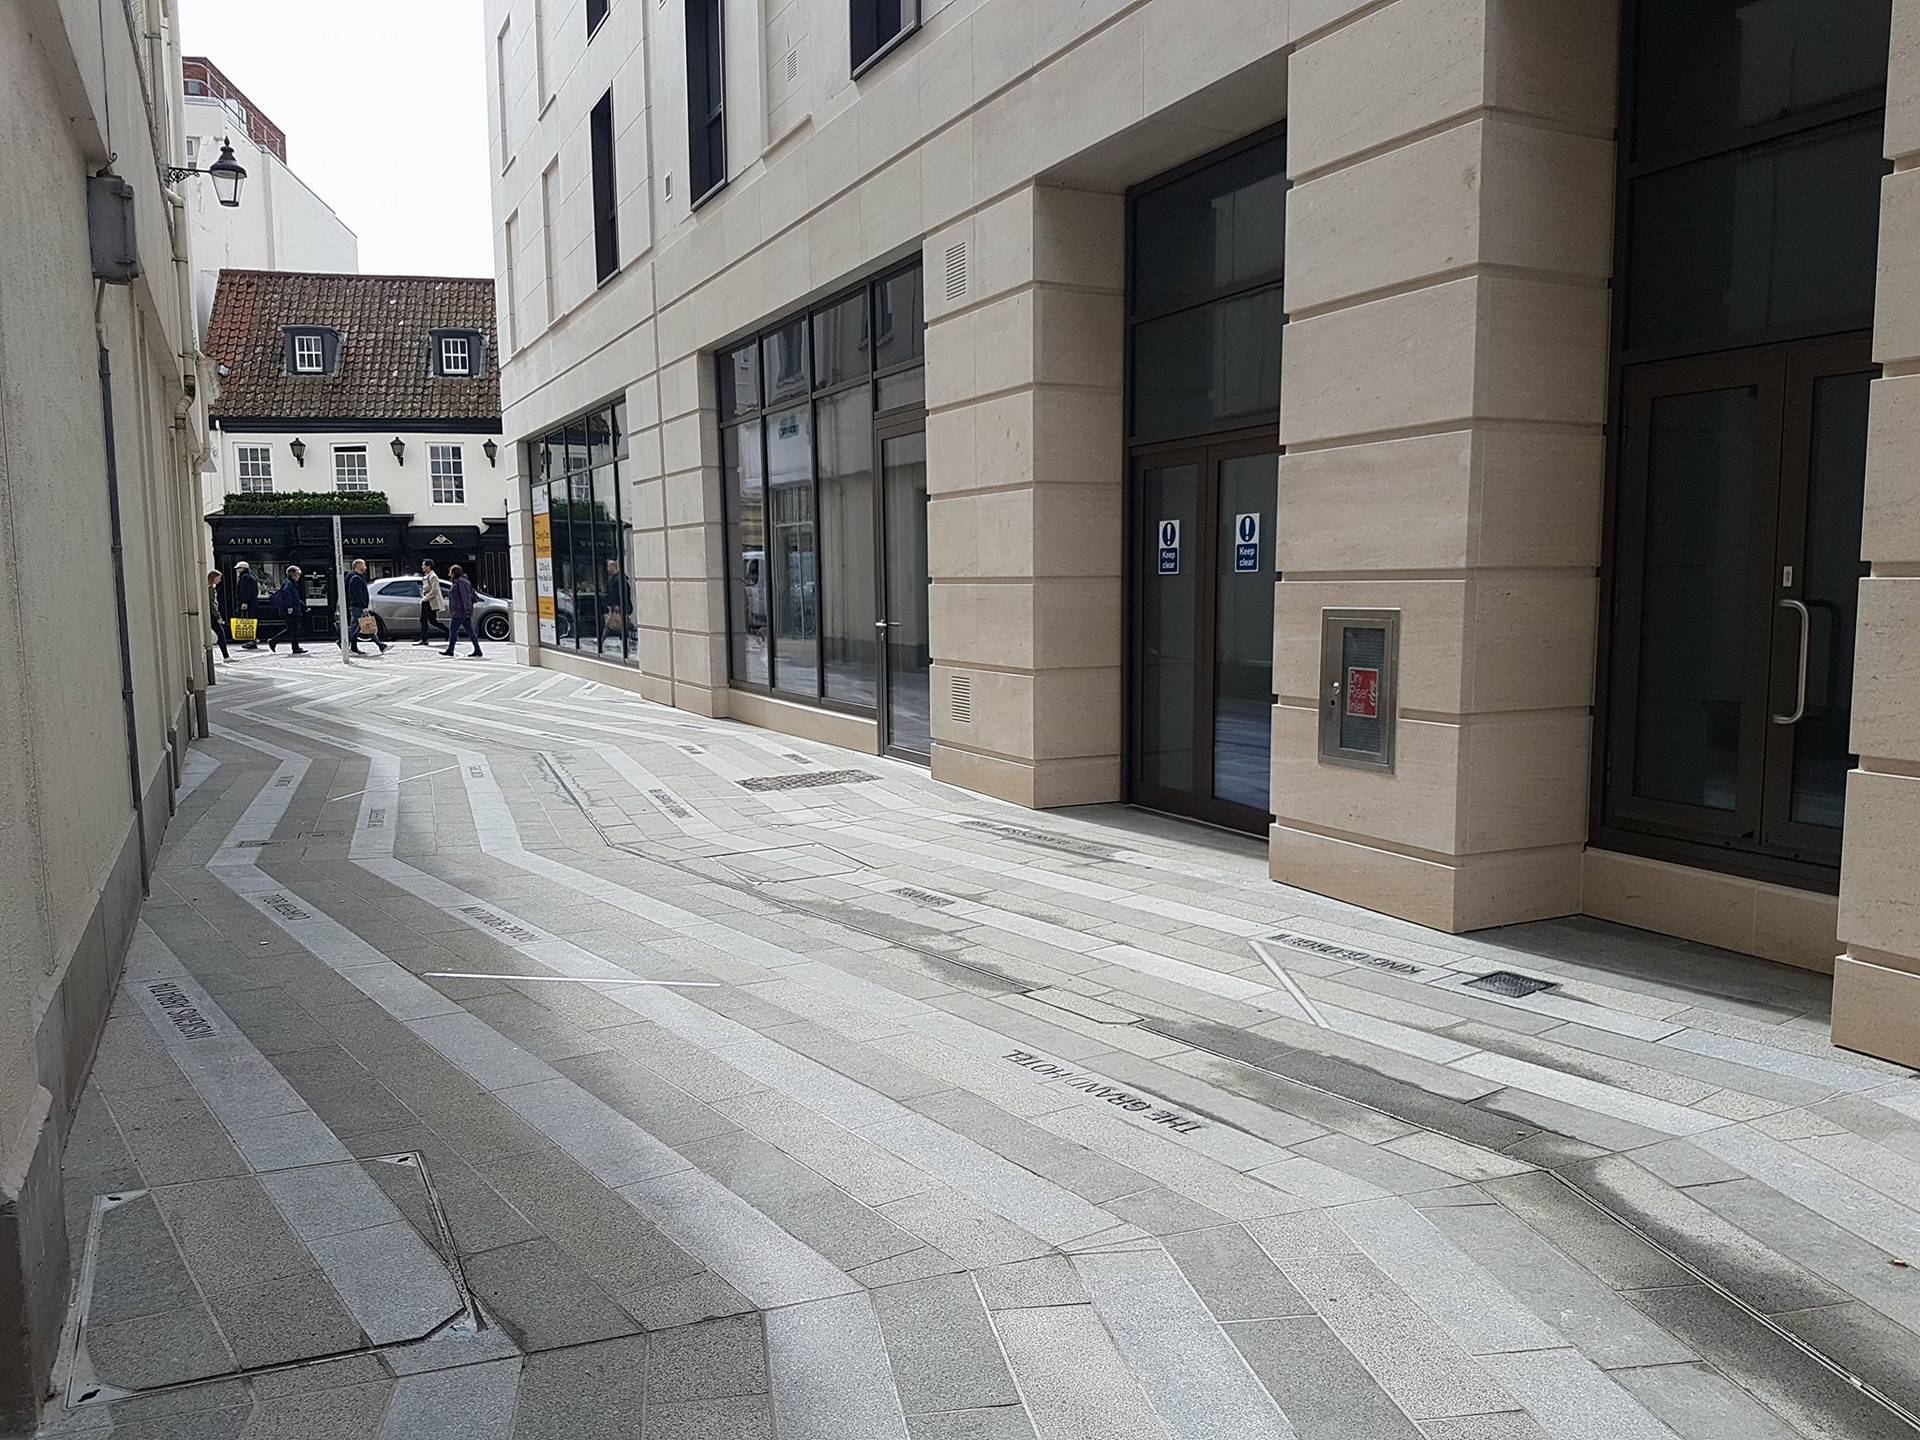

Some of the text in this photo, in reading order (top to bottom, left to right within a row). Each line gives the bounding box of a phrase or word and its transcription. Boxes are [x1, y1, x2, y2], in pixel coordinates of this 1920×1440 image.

[343, 537, 385, 545] AURUM
[1162, 551, 1176, 561] Keep
[1239, 547, 1256, 557] Keep
[1239, 559, 1255, 567] clear
[1349, 684, 1370, 699] Riser
[1284, 937, 1370, 960] GEORGE
[1369, 957, 1426, 975] KING
[1000, 1049, 1202, 1136] THE GRAND HOTEL
